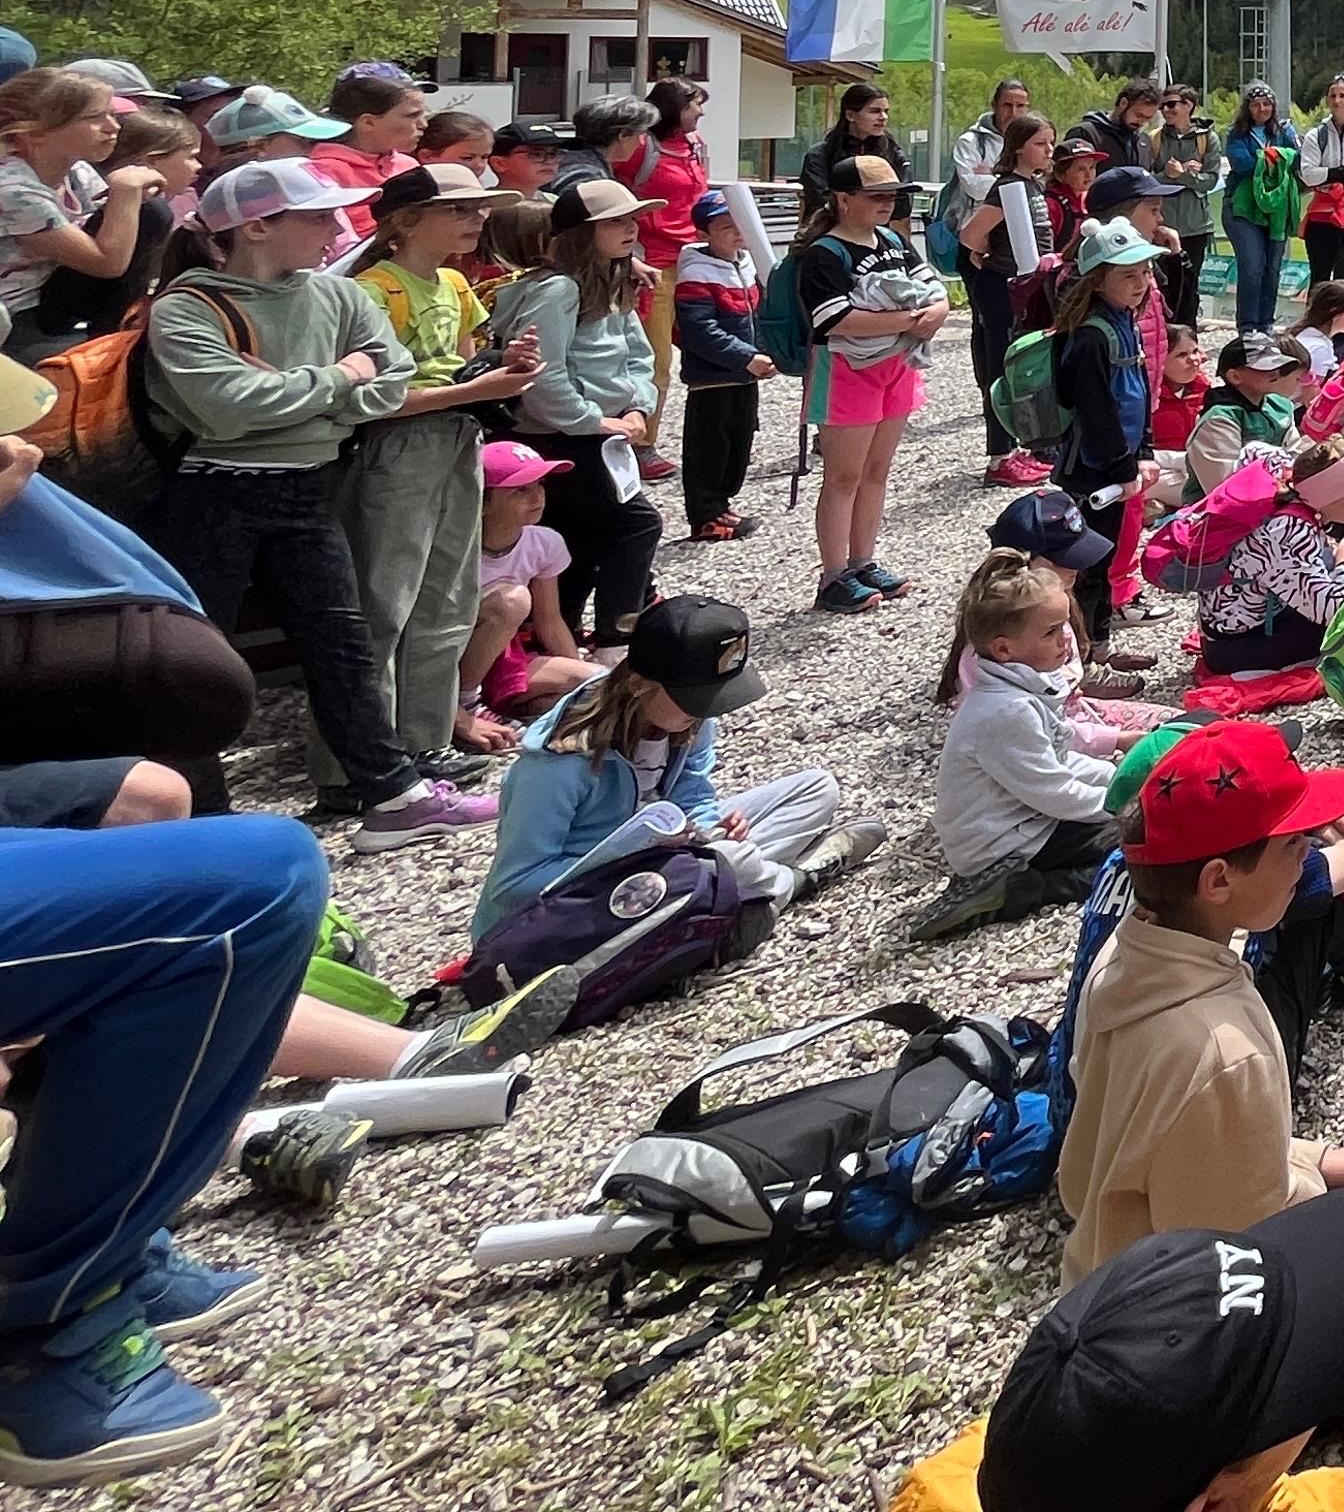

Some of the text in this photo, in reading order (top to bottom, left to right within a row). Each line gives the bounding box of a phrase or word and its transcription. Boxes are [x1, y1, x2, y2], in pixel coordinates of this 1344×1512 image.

[1020, 11, 1134, 33] Alé alé alé!
[1215, 1240, 1265, 1317] NY
